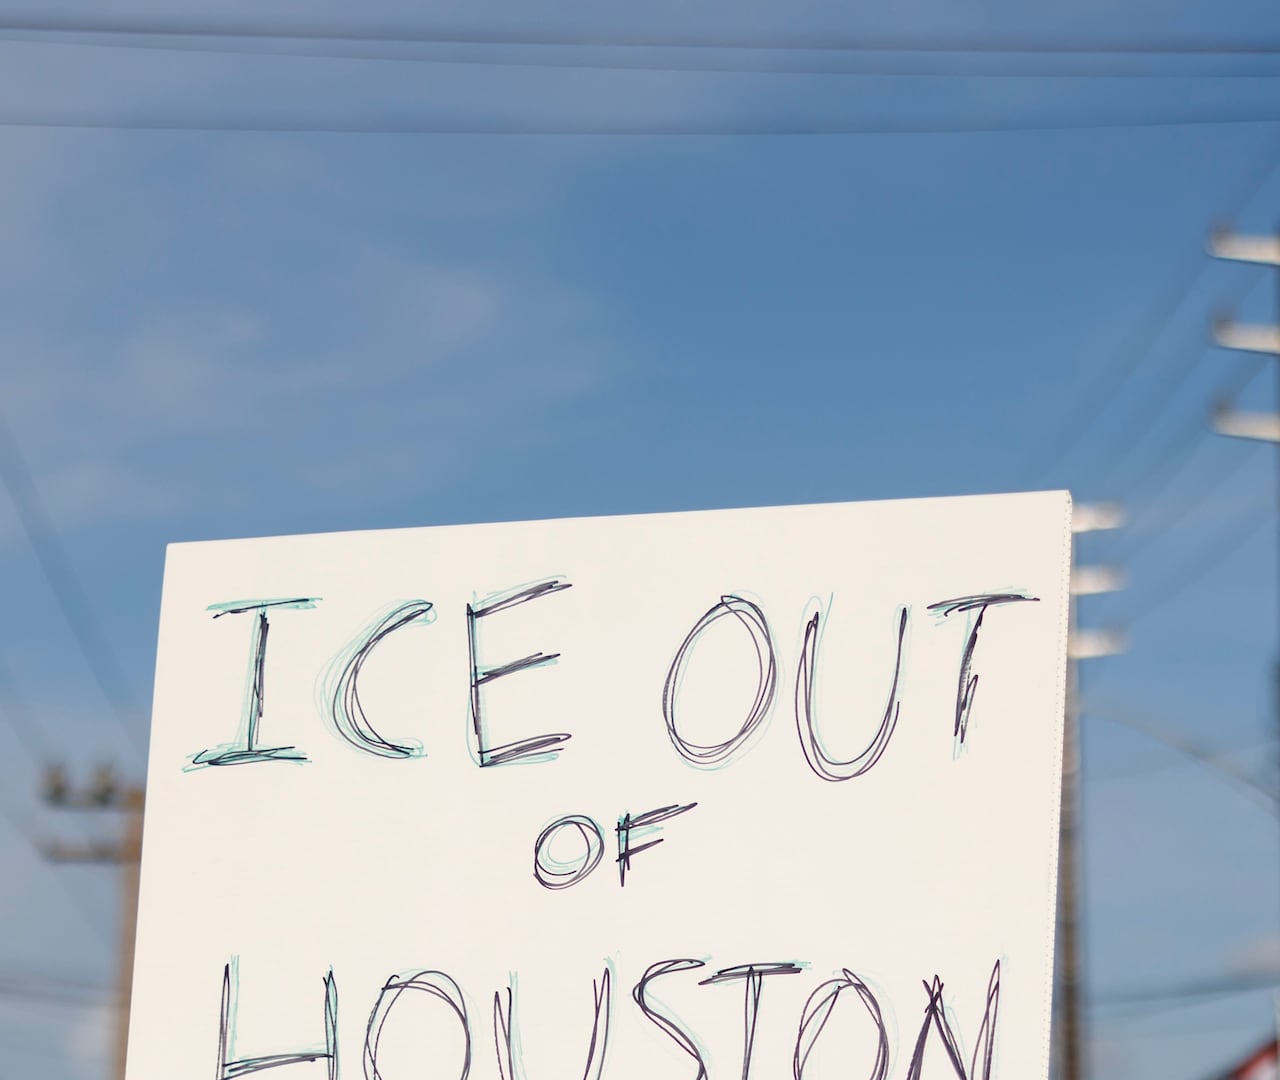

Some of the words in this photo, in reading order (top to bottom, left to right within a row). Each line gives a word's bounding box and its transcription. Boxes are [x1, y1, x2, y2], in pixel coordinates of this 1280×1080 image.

[183, 575, 573, 773] ICE
[661, 585, 1041, 782] OUT
[534, 801, 698, 890] OF
